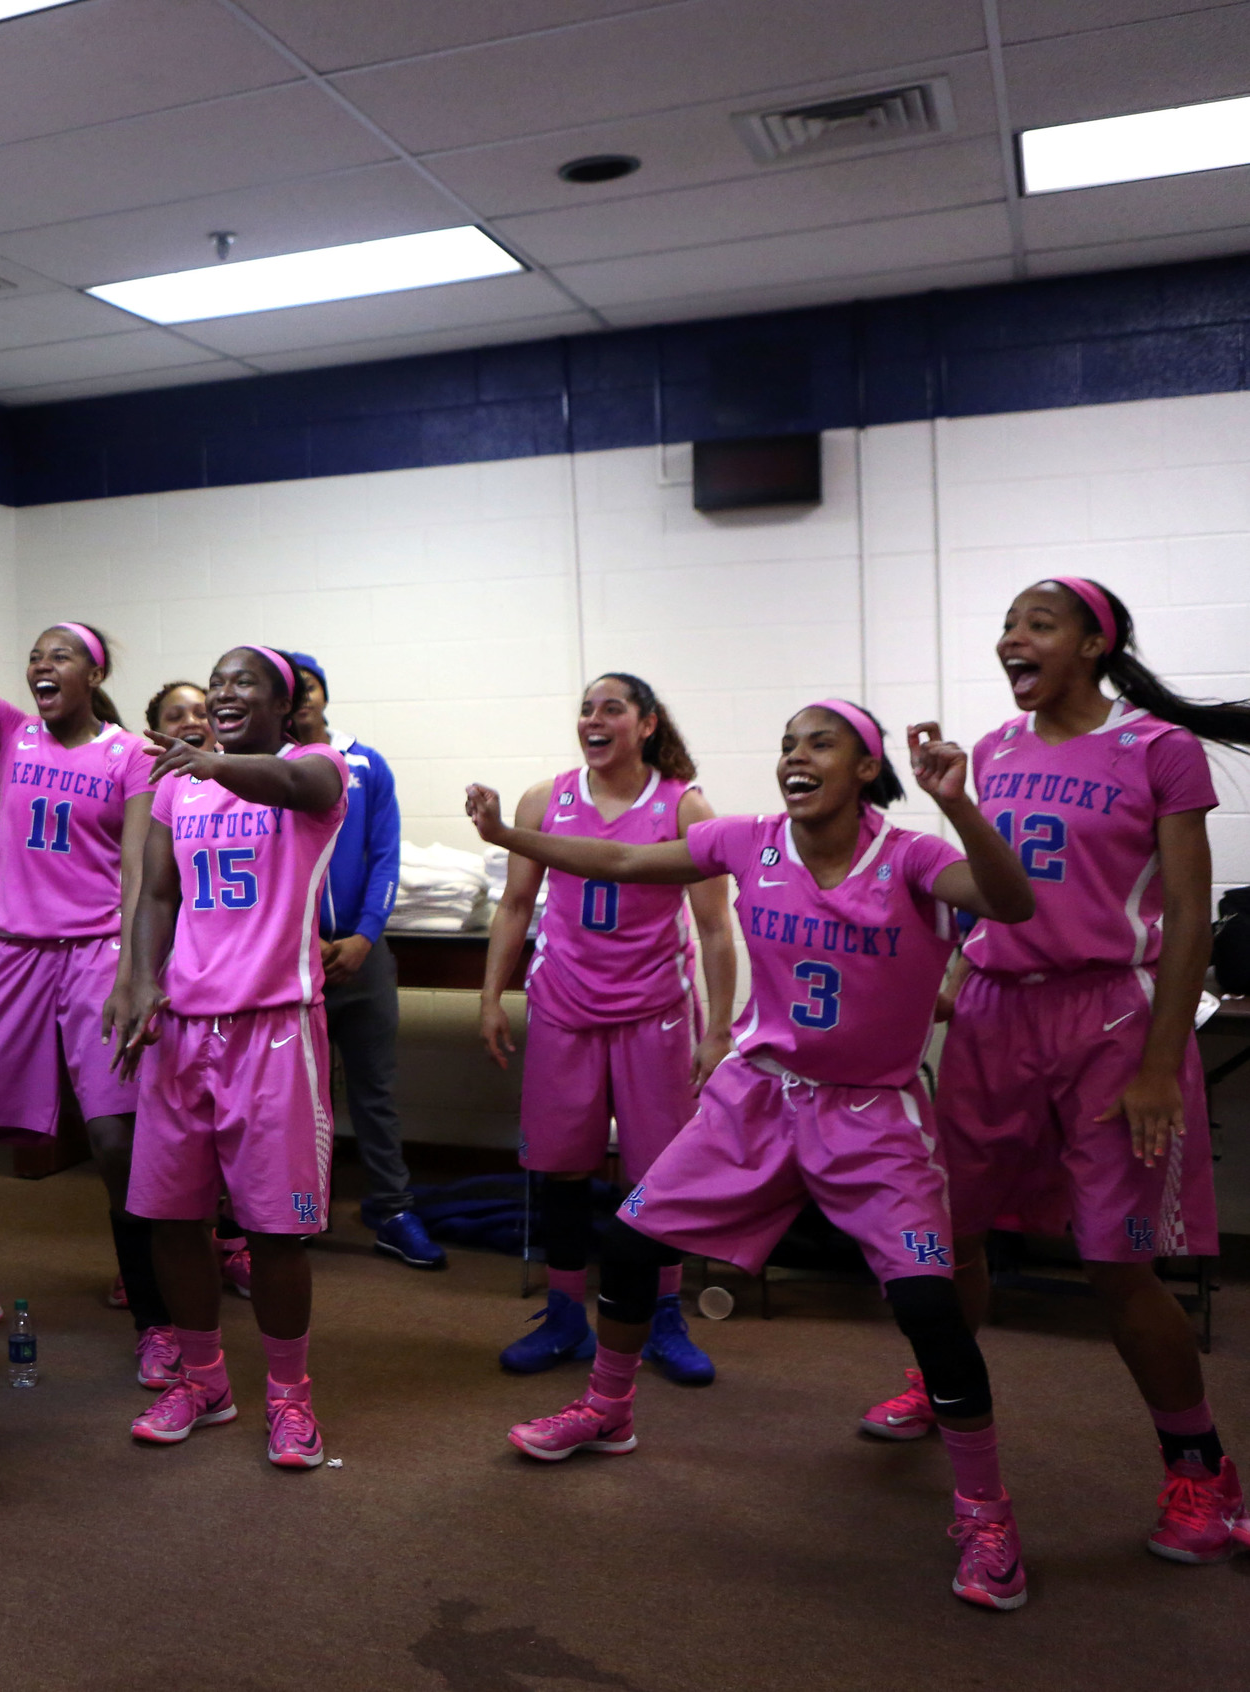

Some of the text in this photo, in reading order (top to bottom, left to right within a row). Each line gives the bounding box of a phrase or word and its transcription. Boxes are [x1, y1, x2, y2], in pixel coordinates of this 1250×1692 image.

[11, 762, 115, 803] KENTUCKY
[981, 773, 1122, 815] KENTUCKY
[26, 796, 72, 854] 11
[175, 807, 284, 840] KENTUCKY
[192, 847, 258, 911] 15
[580, 878, 619, 933] 0
[751, 906, 901, 957] KENTUCKY
[789, 960, 842, 1031] 3
[291, 1192, 318, 1224] UK
[900, 1230, 951, 1268] UK
[1124, 1216, 1154, 1251] UK
